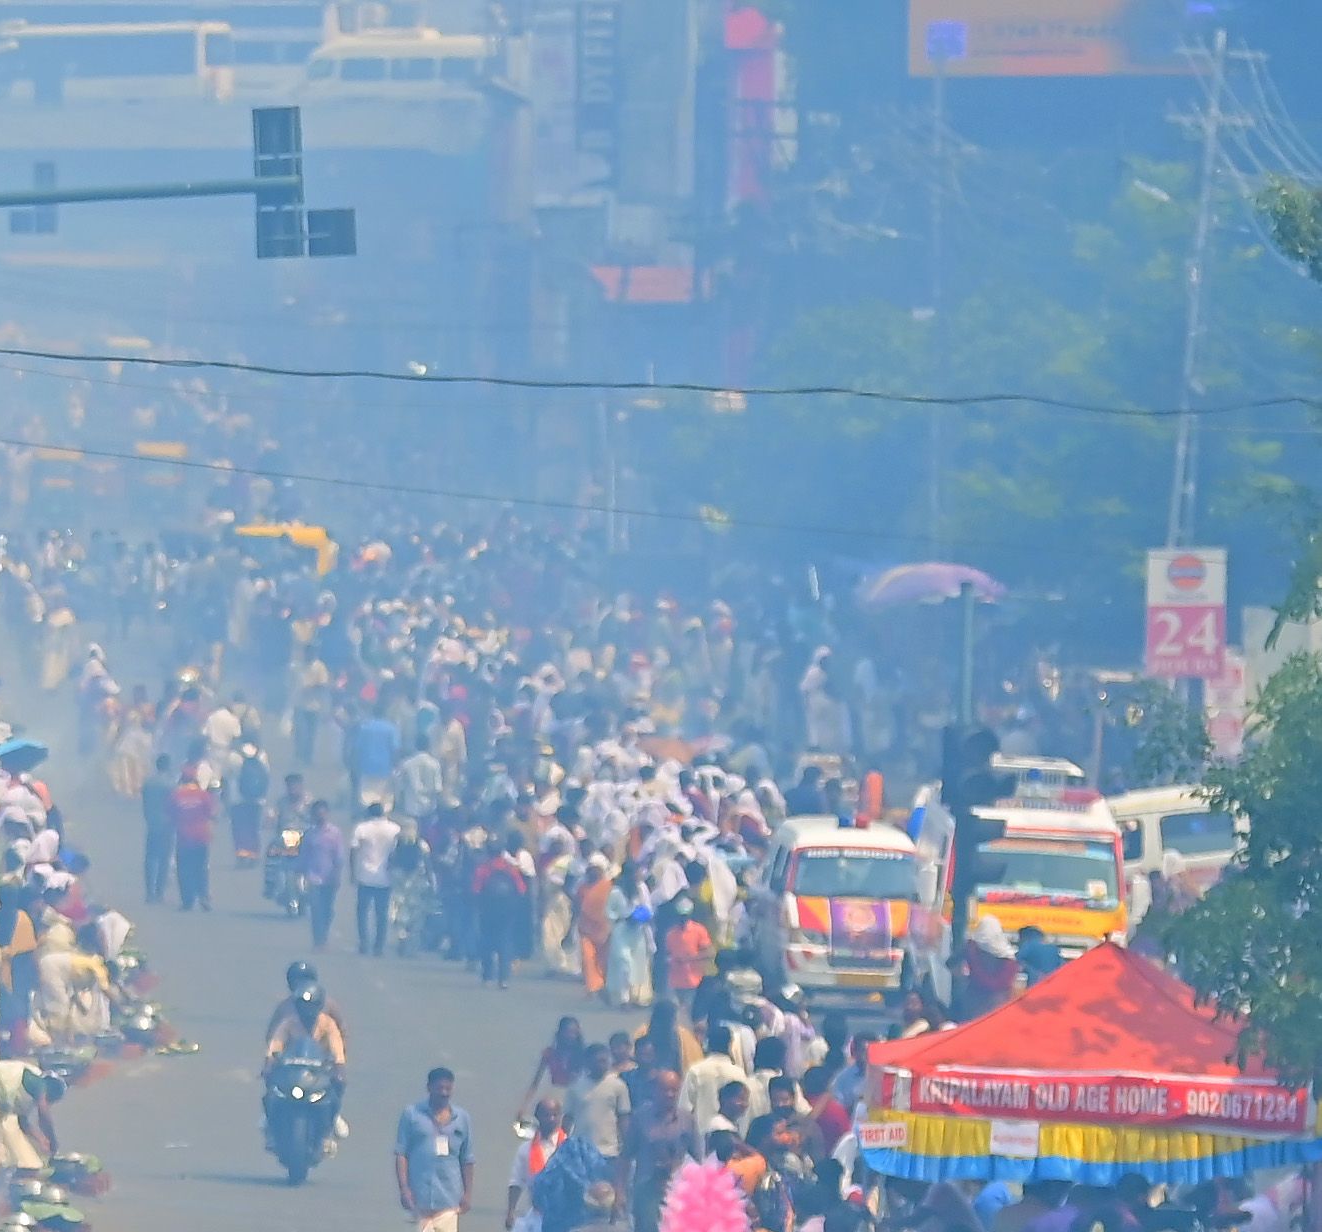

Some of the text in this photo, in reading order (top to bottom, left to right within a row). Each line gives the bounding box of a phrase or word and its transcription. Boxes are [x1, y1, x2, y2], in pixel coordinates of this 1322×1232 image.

[1155, 610, 1218, 656] 24
[1035, 1083, 1070, 1111] OLD
[1073, 1084, 1110, 1113] AGE
[1114, 1085, 1168, 1116] HOME
[1186, 1089, 1298, 1123] 9020671234
[889, 1127, 905, 1142] AID
